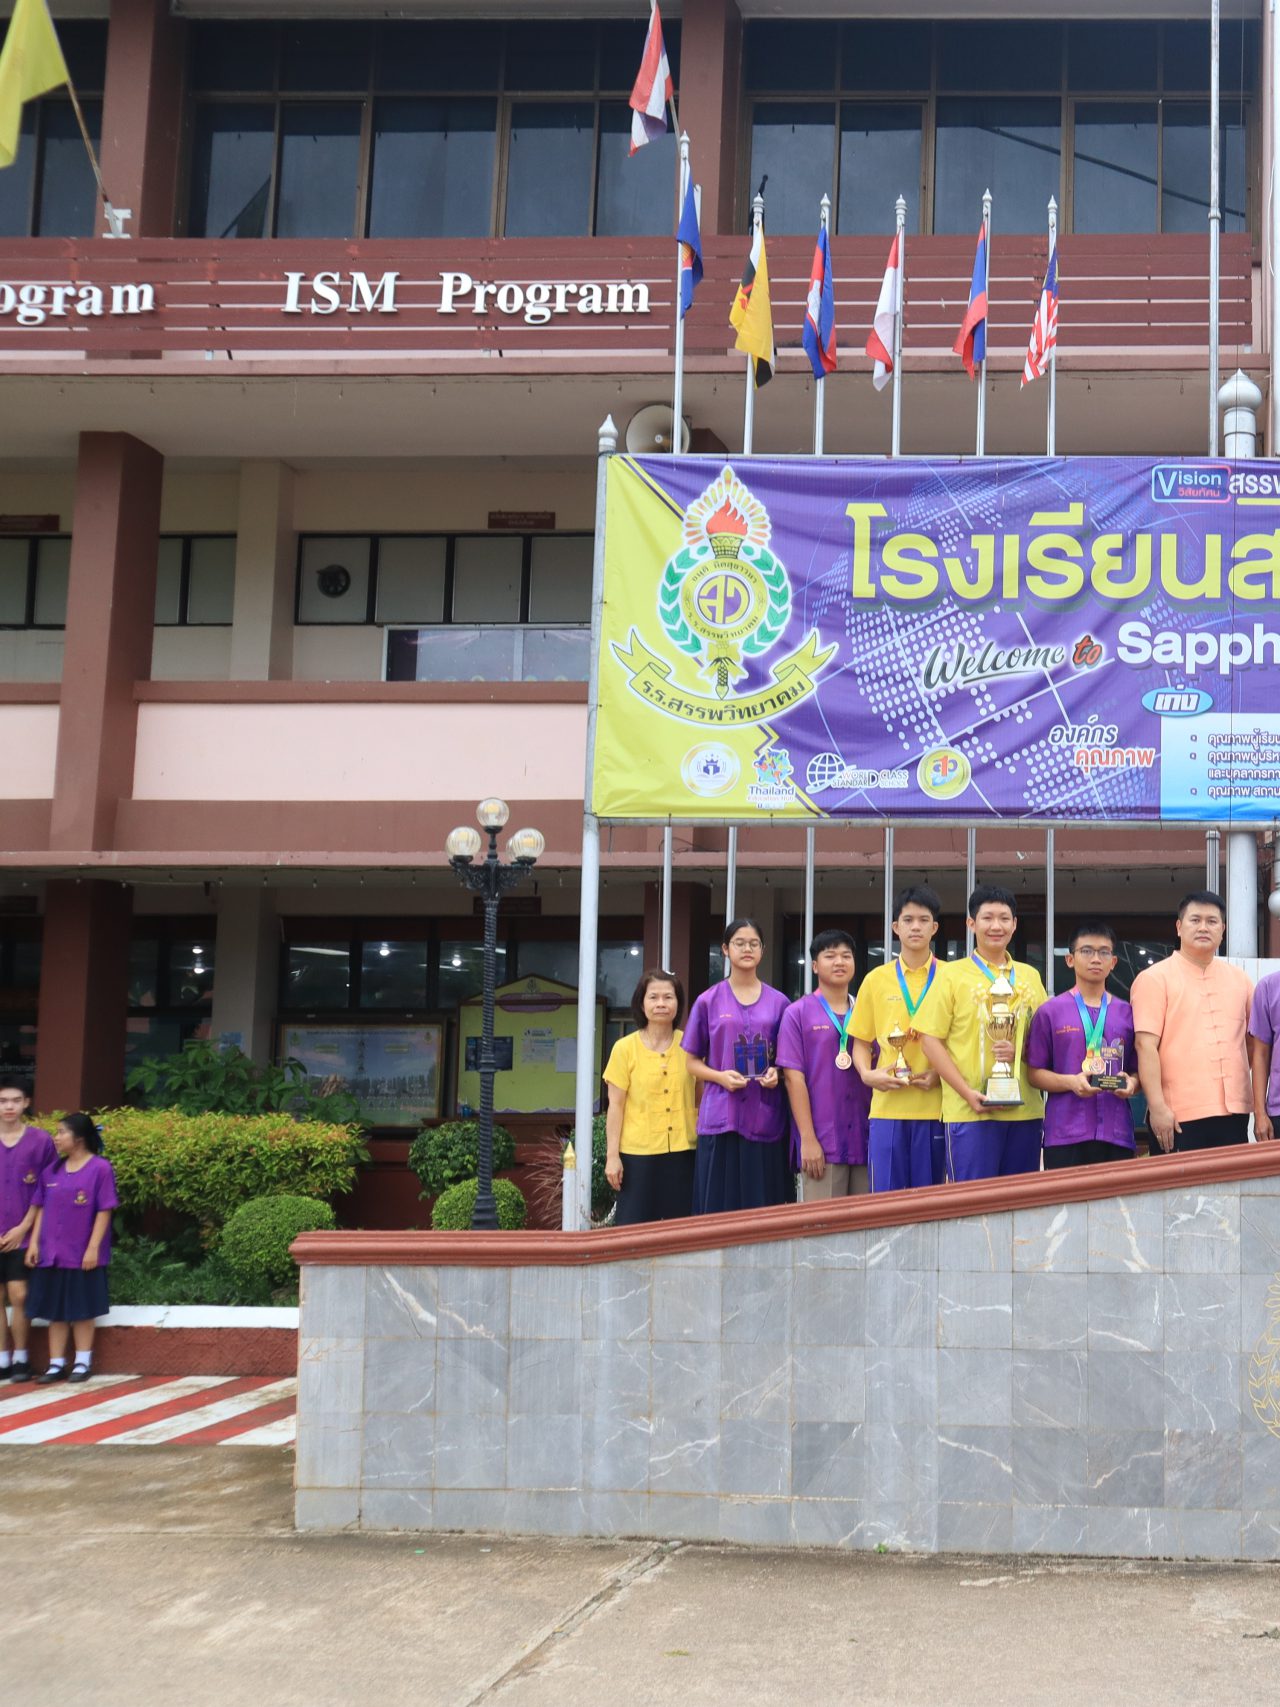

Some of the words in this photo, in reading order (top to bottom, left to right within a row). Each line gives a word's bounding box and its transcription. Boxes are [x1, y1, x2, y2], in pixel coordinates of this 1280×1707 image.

[281, 271, 400, 315] ISM
[437, 271, 652, 326] Program
[1157, 470, 1222, 497] Vision
[923, 640, 1065, 689] Welcome
[1072, 634, 1103, 667] to
[642, 679, 806, 721] ร.ร.สรรพวิทยาคม
[1050, 714, 1118, 745] องค์กร
[1074, 746, 1155, 774] คุณภาพ
[749, 785, 795, 795] Thailand
[1208, 786, 1249, 799] คุณภาพ
